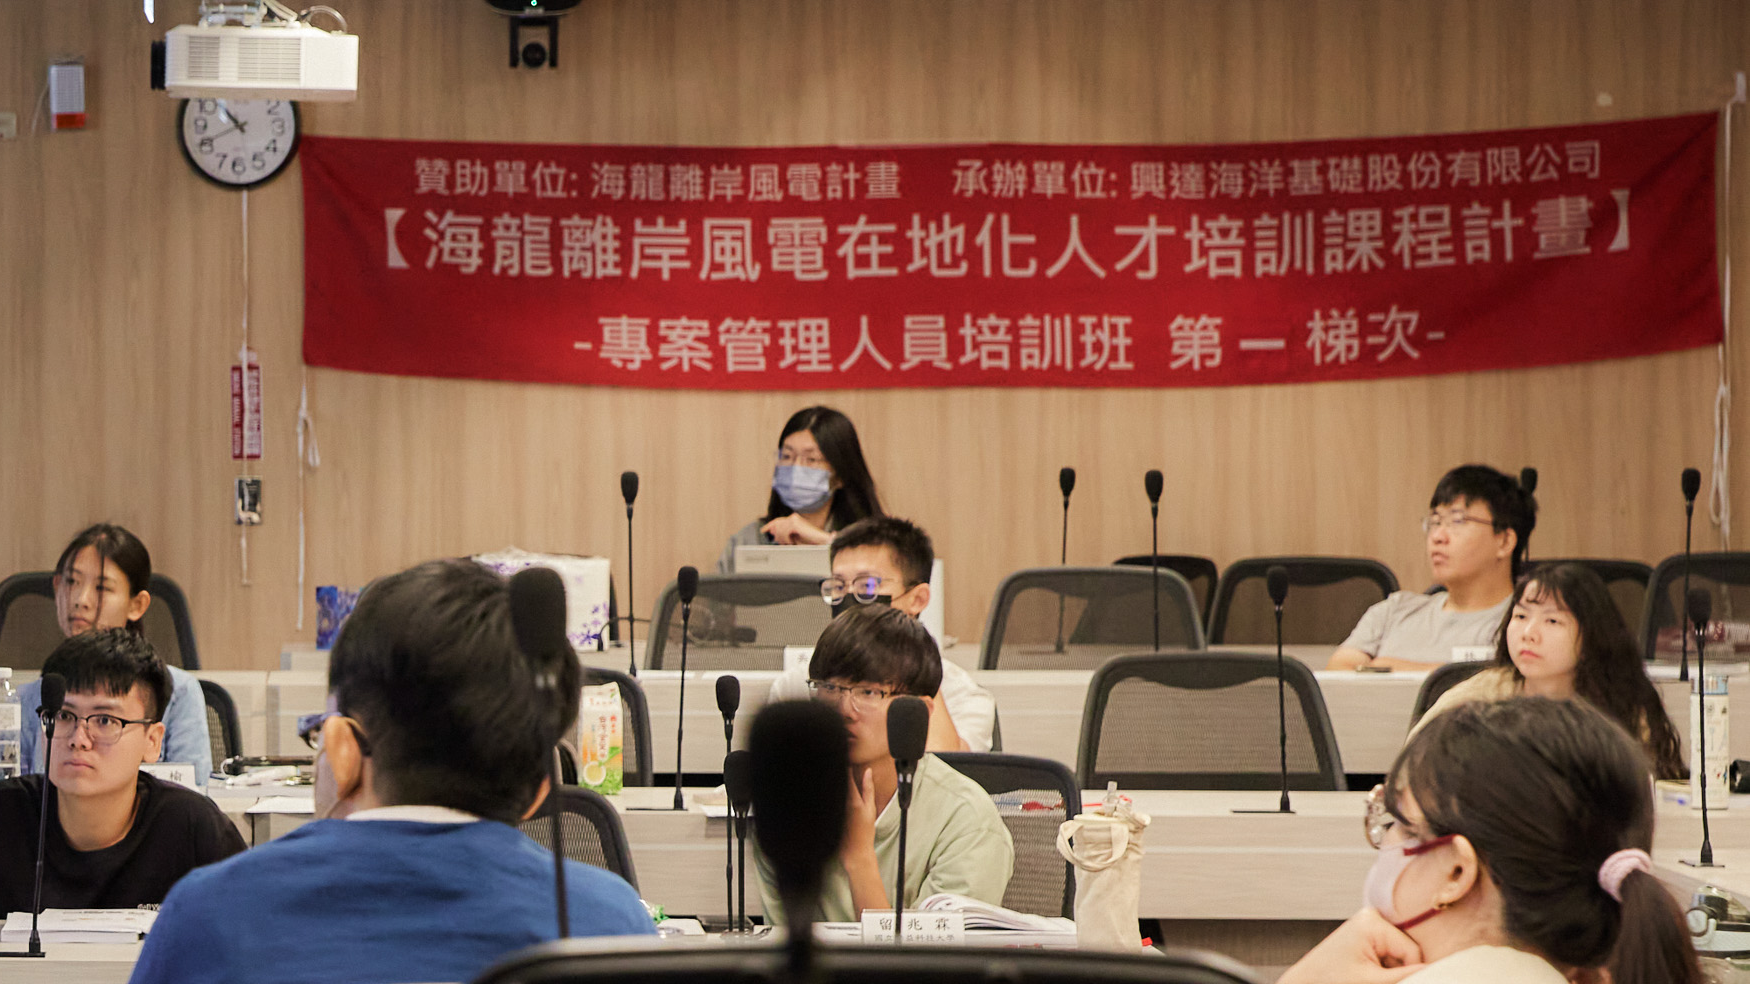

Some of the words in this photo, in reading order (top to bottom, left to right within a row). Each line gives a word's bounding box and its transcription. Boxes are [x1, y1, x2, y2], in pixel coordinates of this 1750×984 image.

[195, 118, 207, 134] 9
[272, 118, 285, 136] 3
[266, 139, 278, 153] 4
[216, 153, 228, 169] 7
[232, 158, 245, 175] 6
[253, 153, 266, 170] 5
[591, 161, 902, 203] 海龍離岸風電計畫
[952, 159, 1118, 200] 承辦單位:
[1129, 141, 1601, 200] 興達海洋基礎股份有限公司
[384, 188, 1631, 284] 【海龍離岸風電在地化人才培訓課程計畫】
[875, 934, 955, 942] 國立益科技大學
